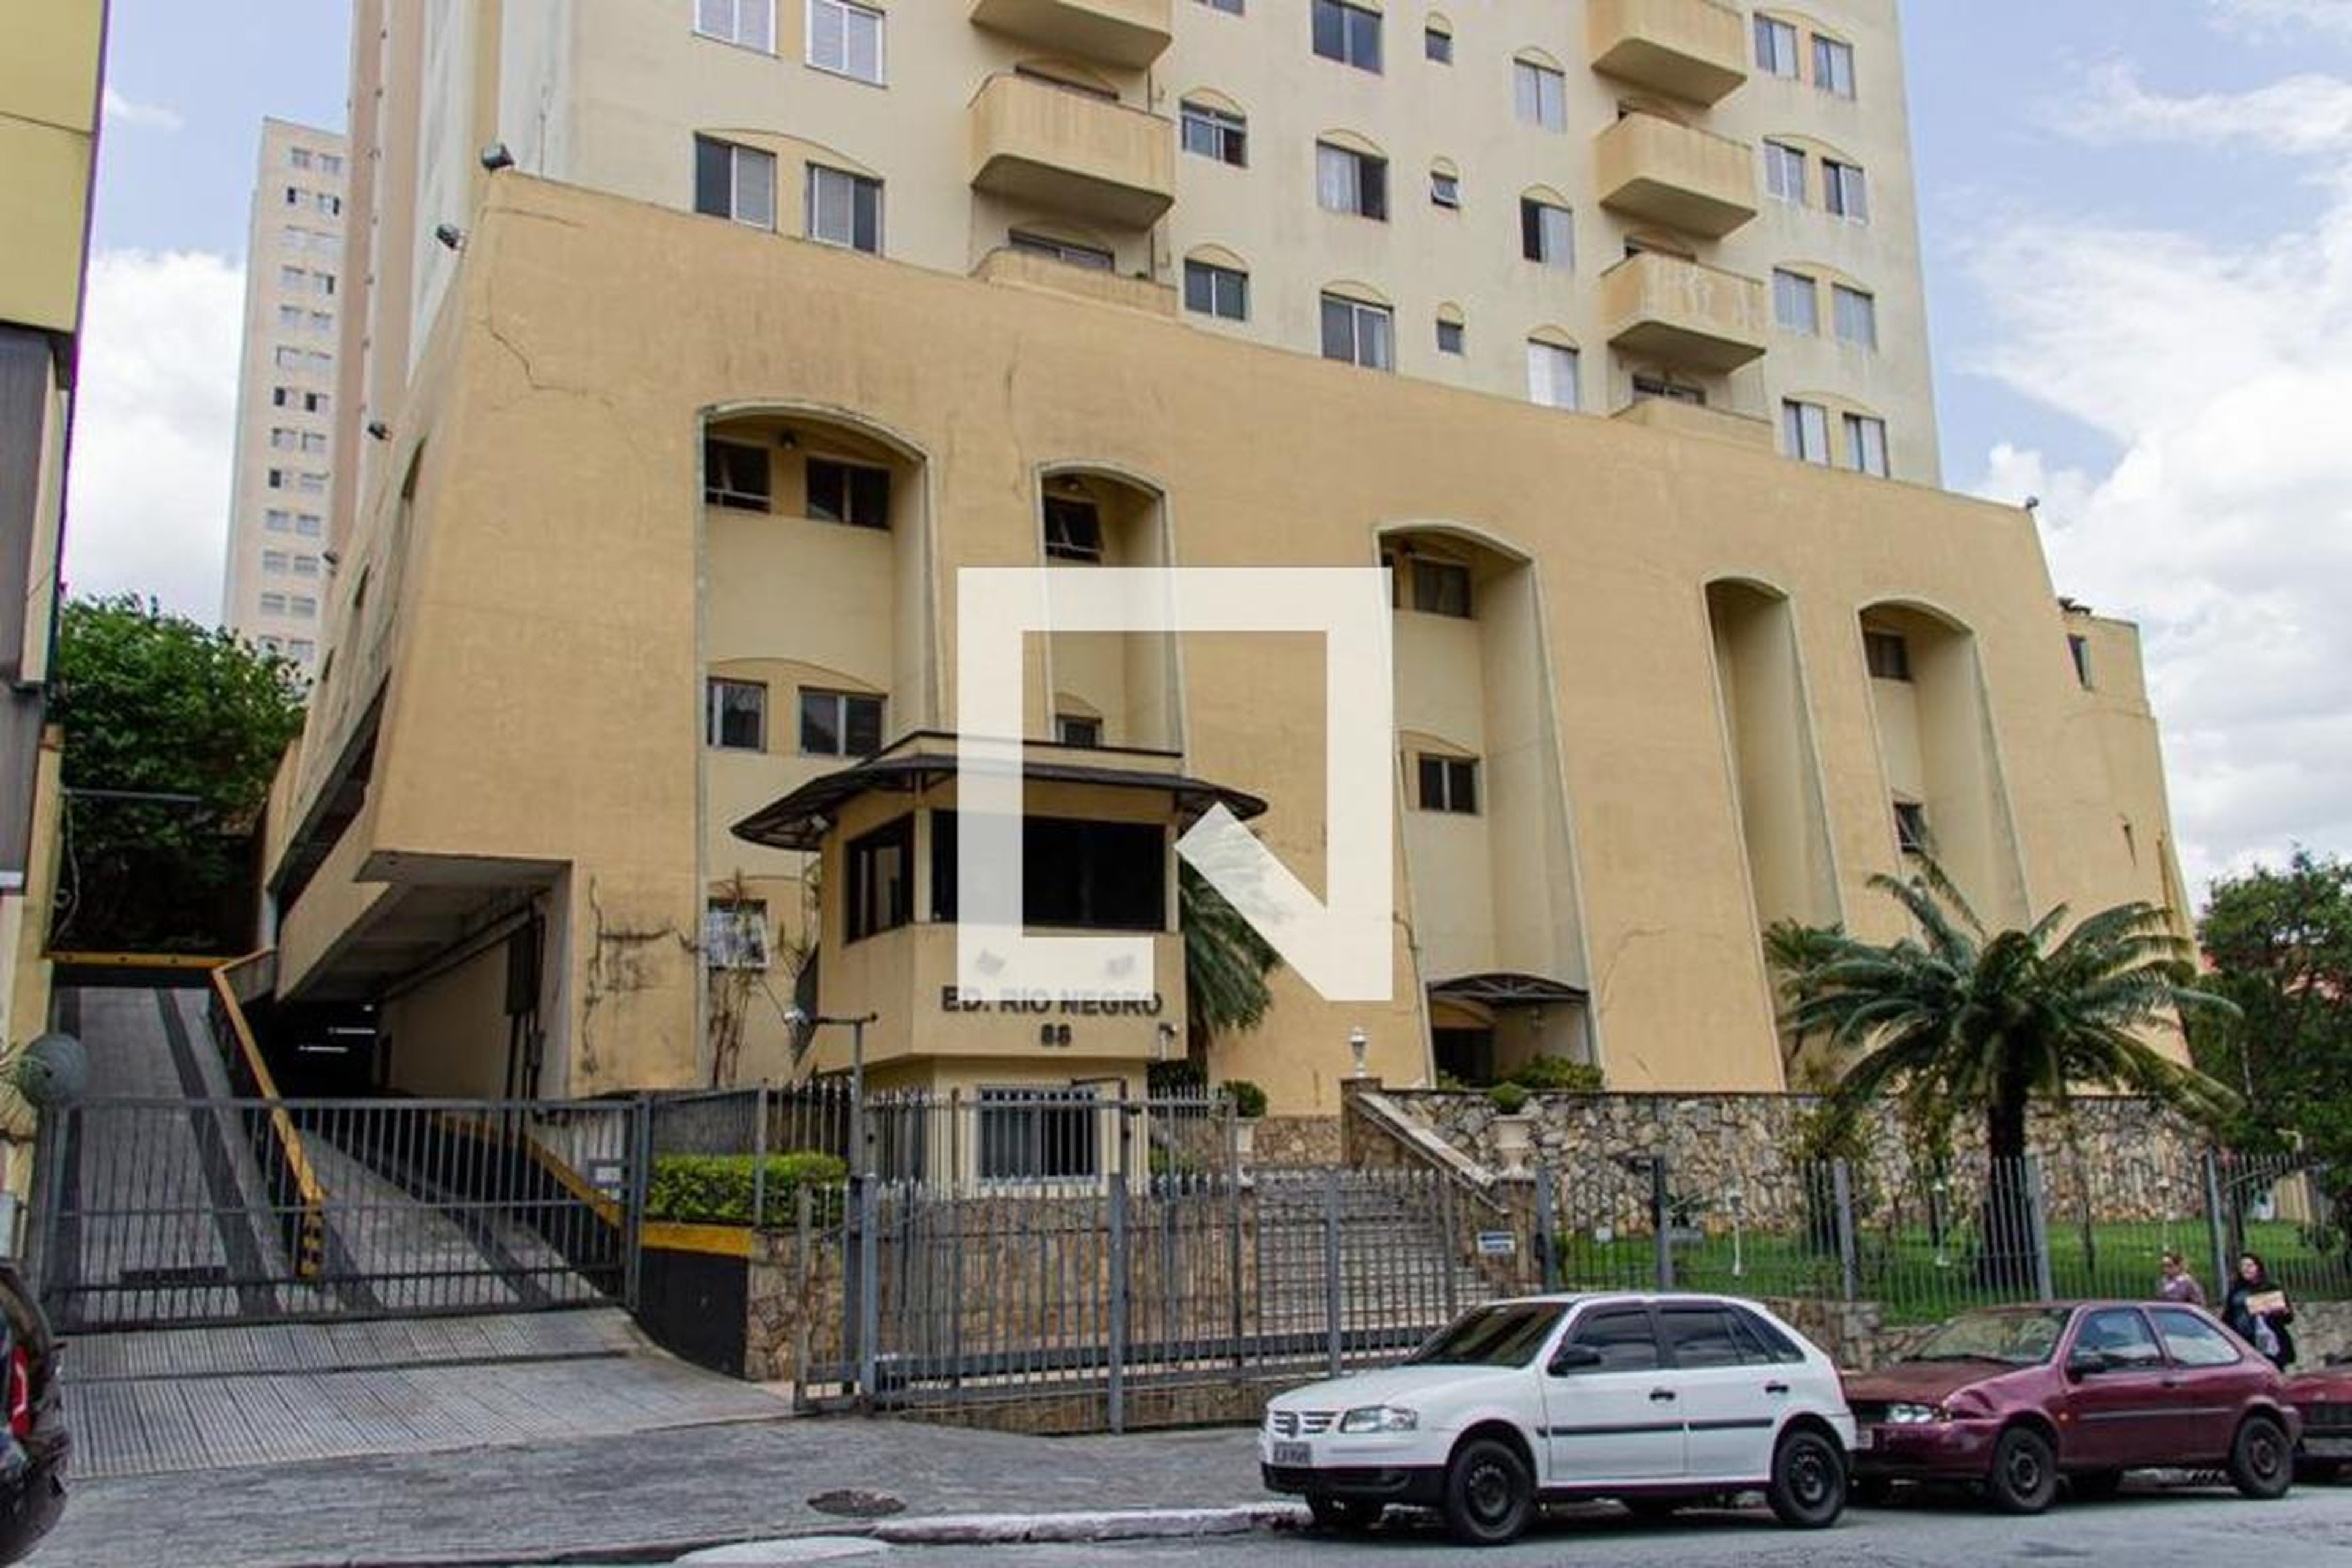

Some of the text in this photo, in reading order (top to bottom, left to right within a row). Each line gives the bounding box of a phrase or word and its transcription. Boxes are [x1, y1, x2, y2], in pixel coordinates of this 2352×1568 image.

[941, 986, 1163, 1016] ED. RIO NEGRO
